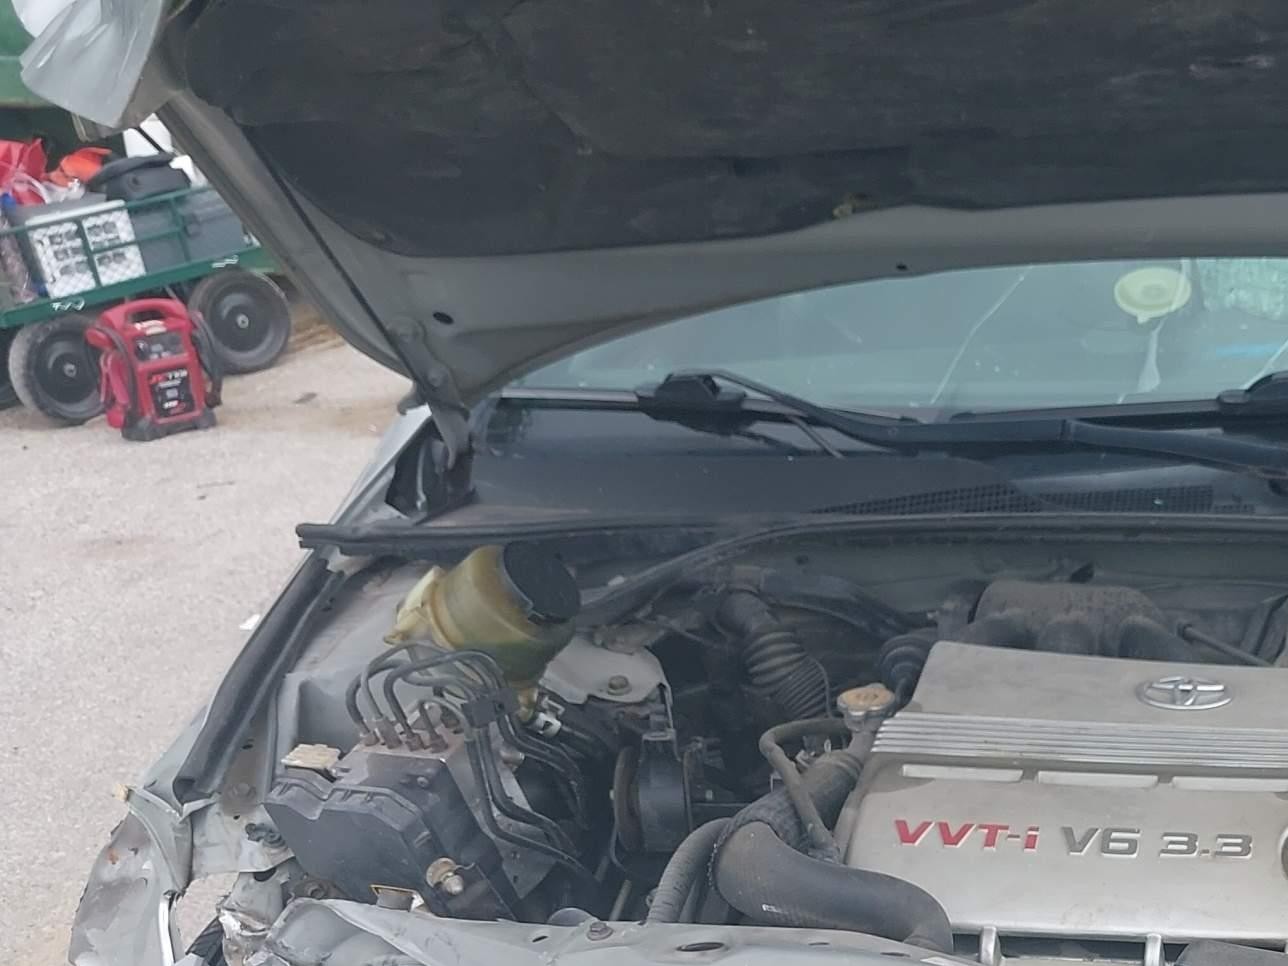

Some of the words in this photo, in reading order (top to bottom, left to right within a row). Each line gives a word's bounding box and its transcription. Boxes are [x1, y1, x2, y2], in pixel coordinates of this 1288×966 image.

[894, 819, 1040, 853] VVT-i
[1060, 826, 1141, 858] V6
[1159, 831, 1253, 858] 3.3
